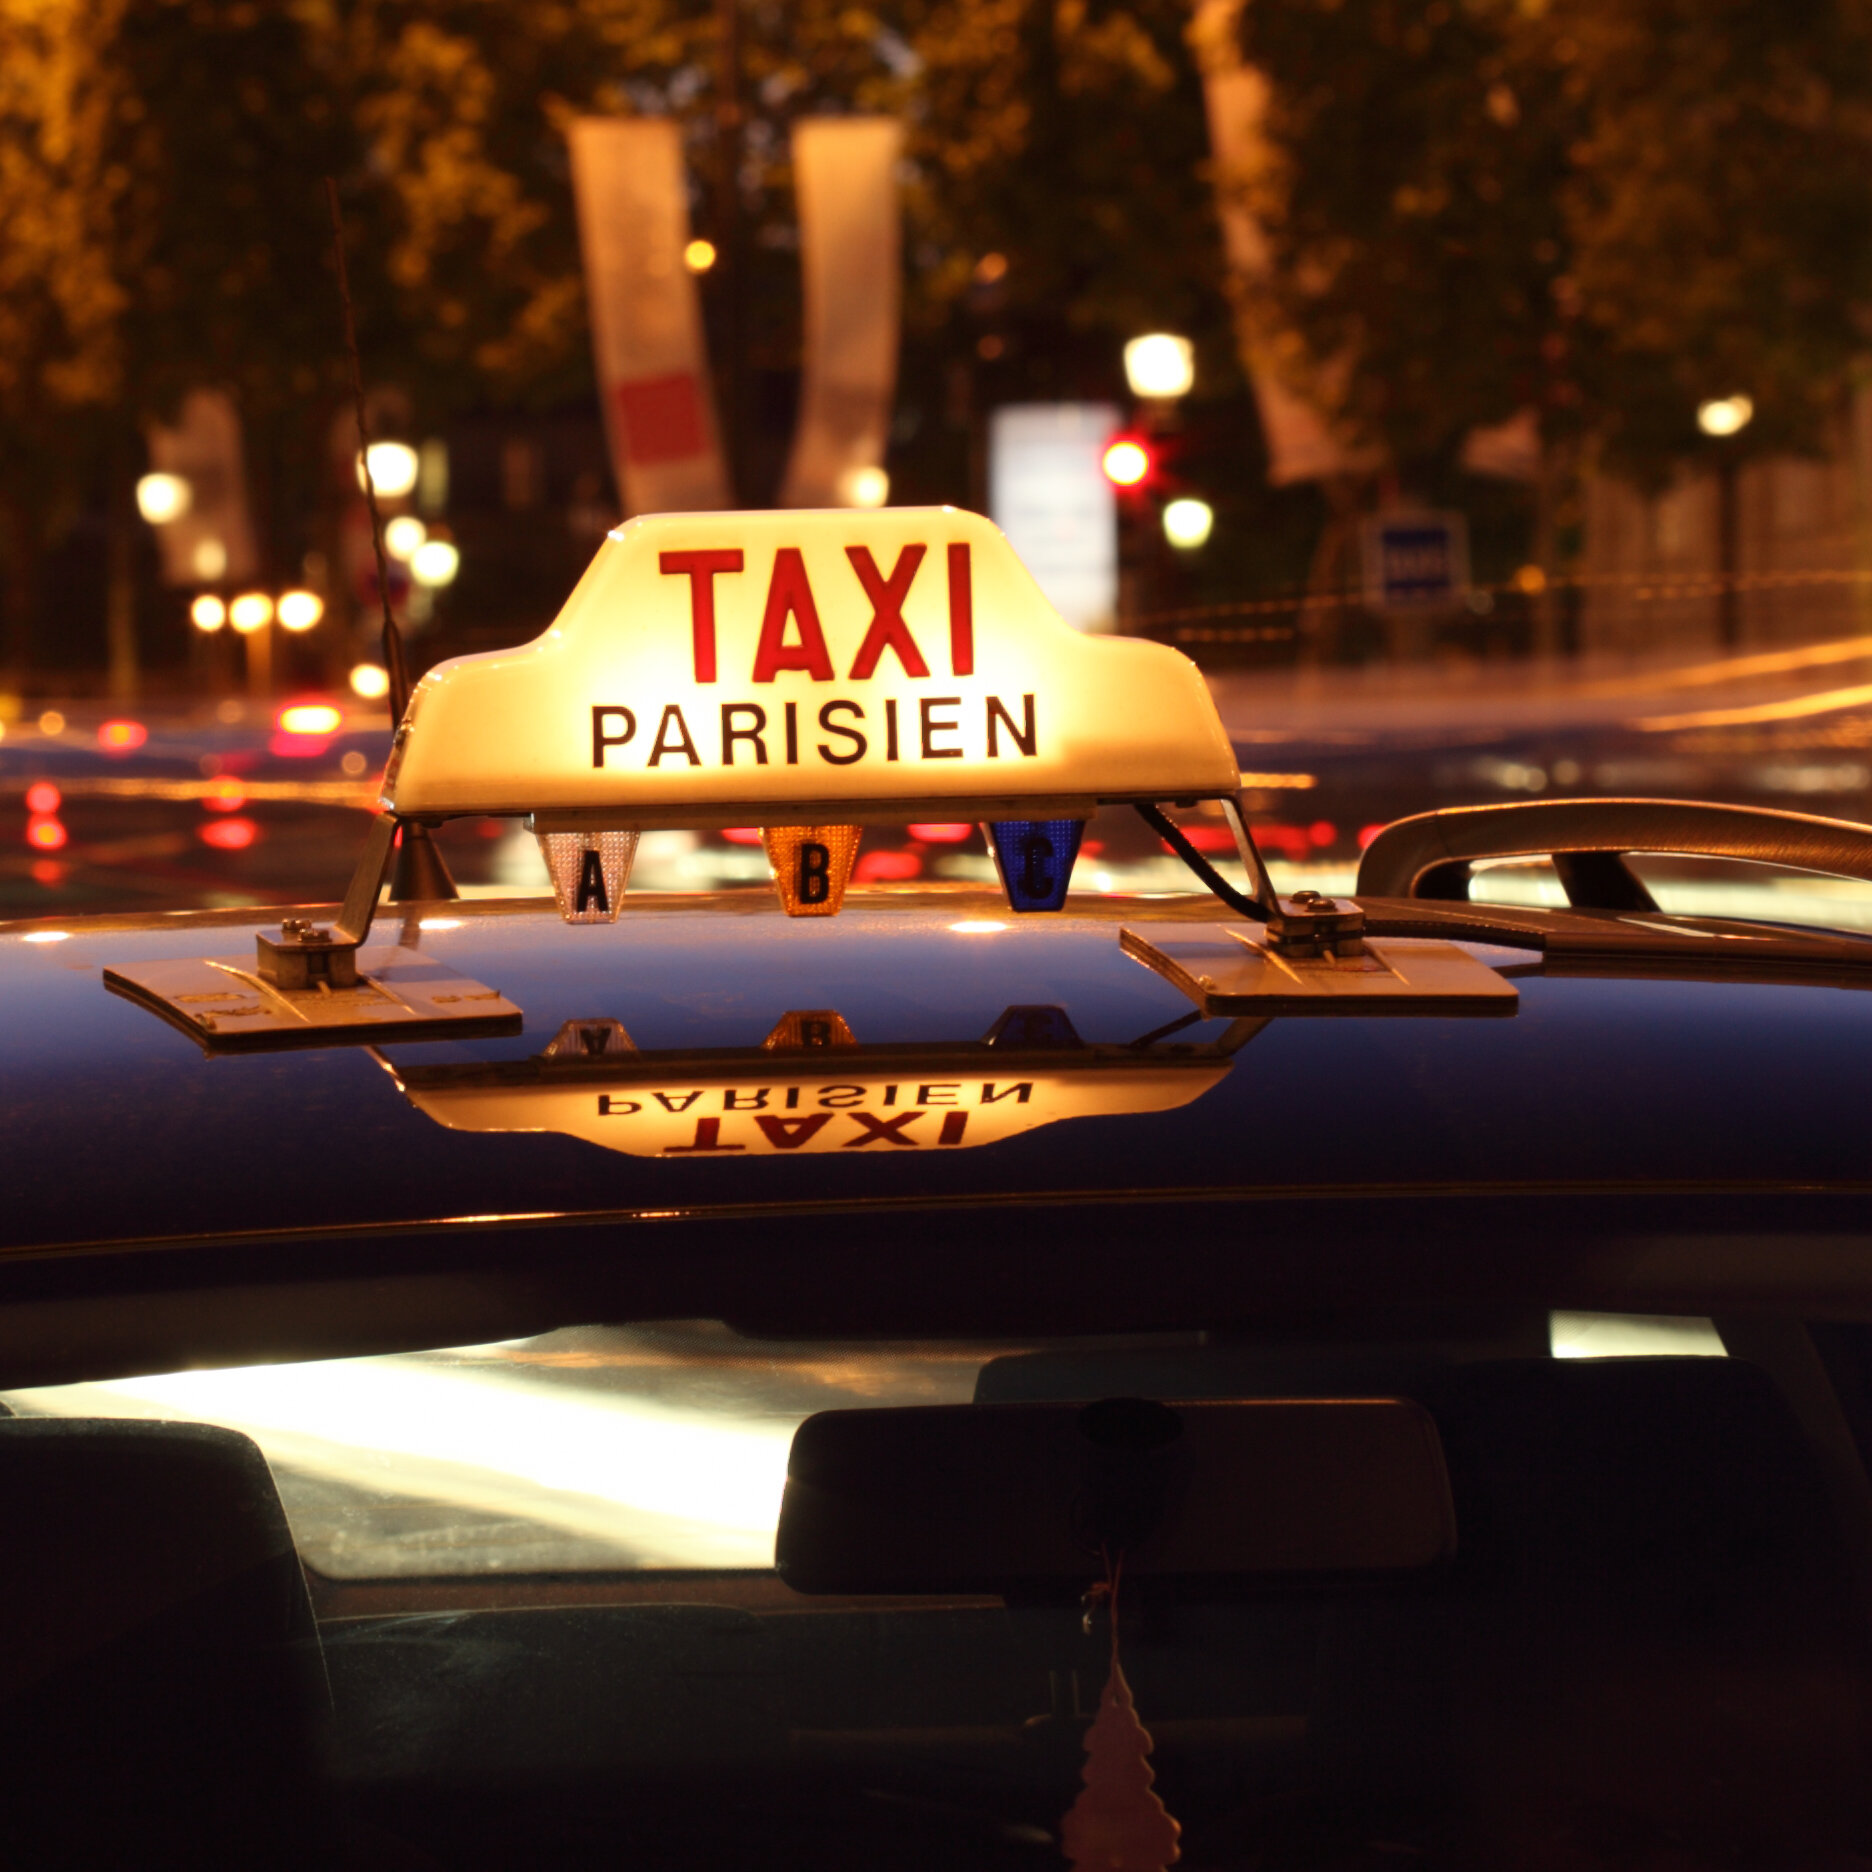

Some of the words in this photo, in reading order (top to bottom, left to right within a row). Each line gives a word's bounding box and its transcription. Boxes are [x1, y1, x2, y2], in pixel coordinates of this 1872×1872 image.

[659, 543, 975, 683] TAXI
[591, 694, 1038, 767] PARISIEN
[575, 849, 610, 912] A
[798, 842, 829, 904] B
[1018, 836, 1054, 899] C
